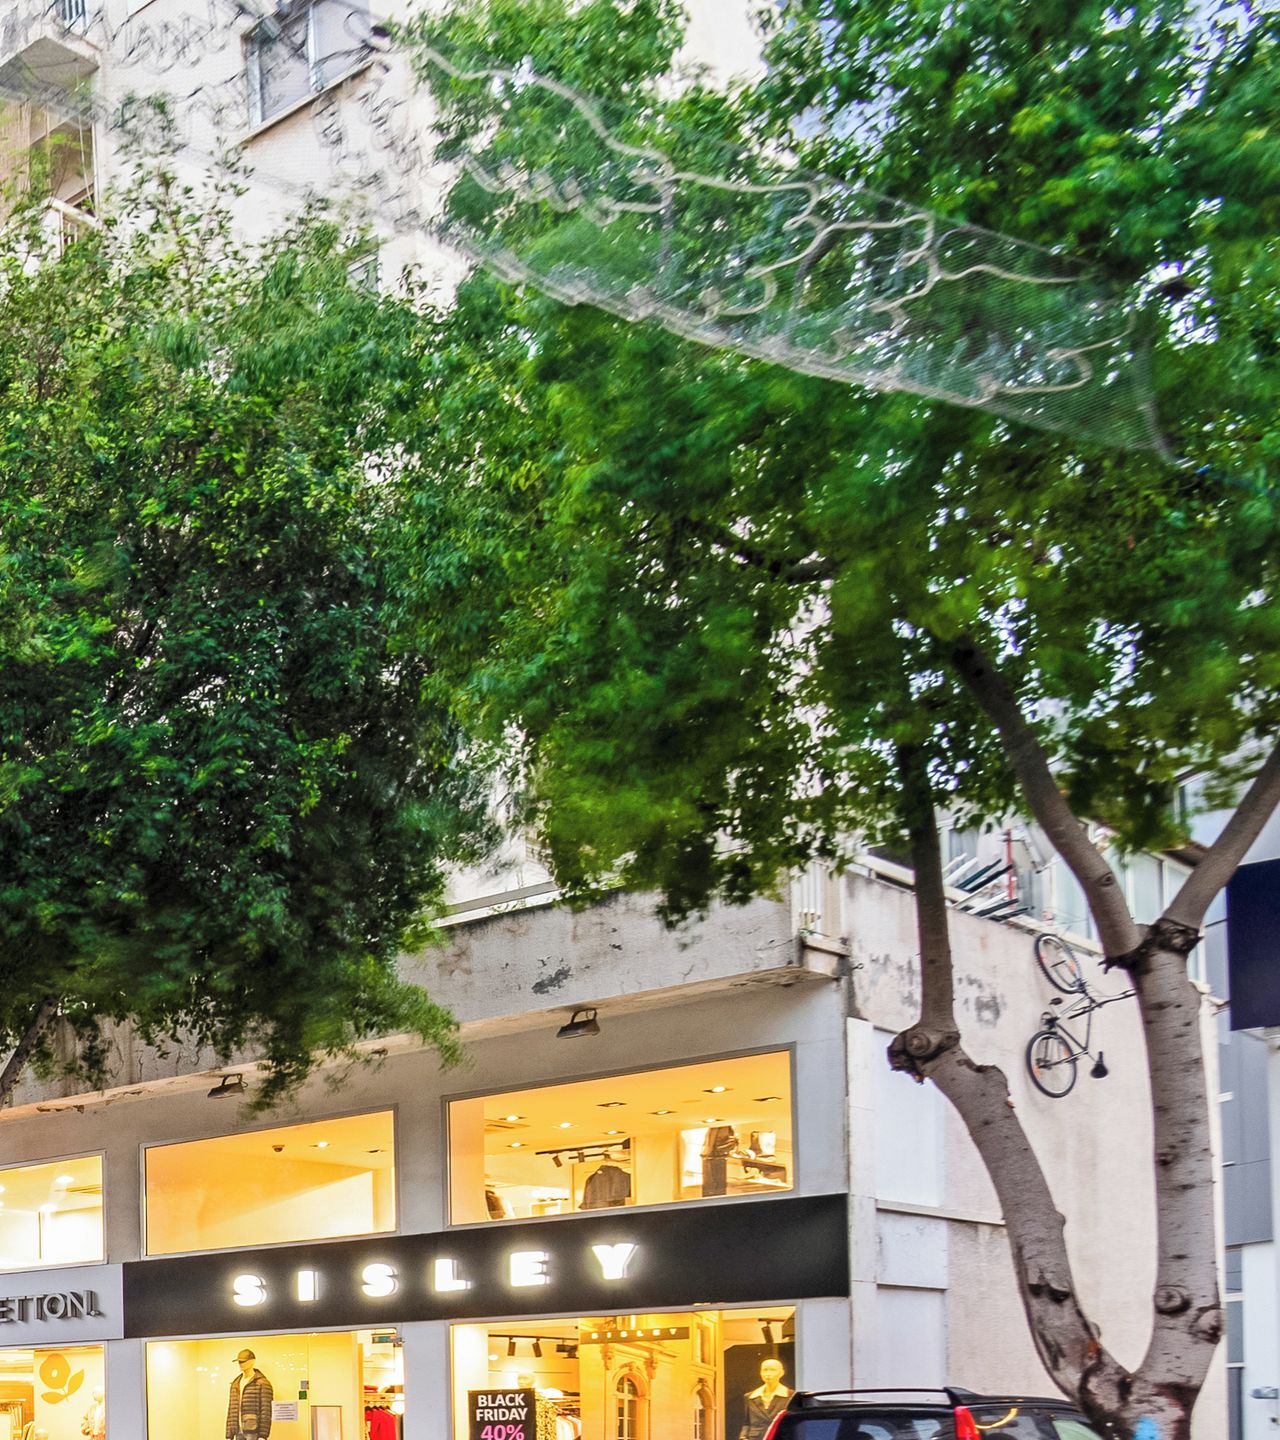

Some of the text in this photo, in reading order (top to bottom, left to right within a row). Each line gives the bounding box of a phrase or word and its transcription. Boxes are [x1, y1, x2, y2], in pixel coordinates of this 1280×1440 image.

[233, 1242, 638, 1307] SISLEY
[477, 1393, 525, 1408] BLACK
[475, 1407, 528, 1421] FRIDAY
